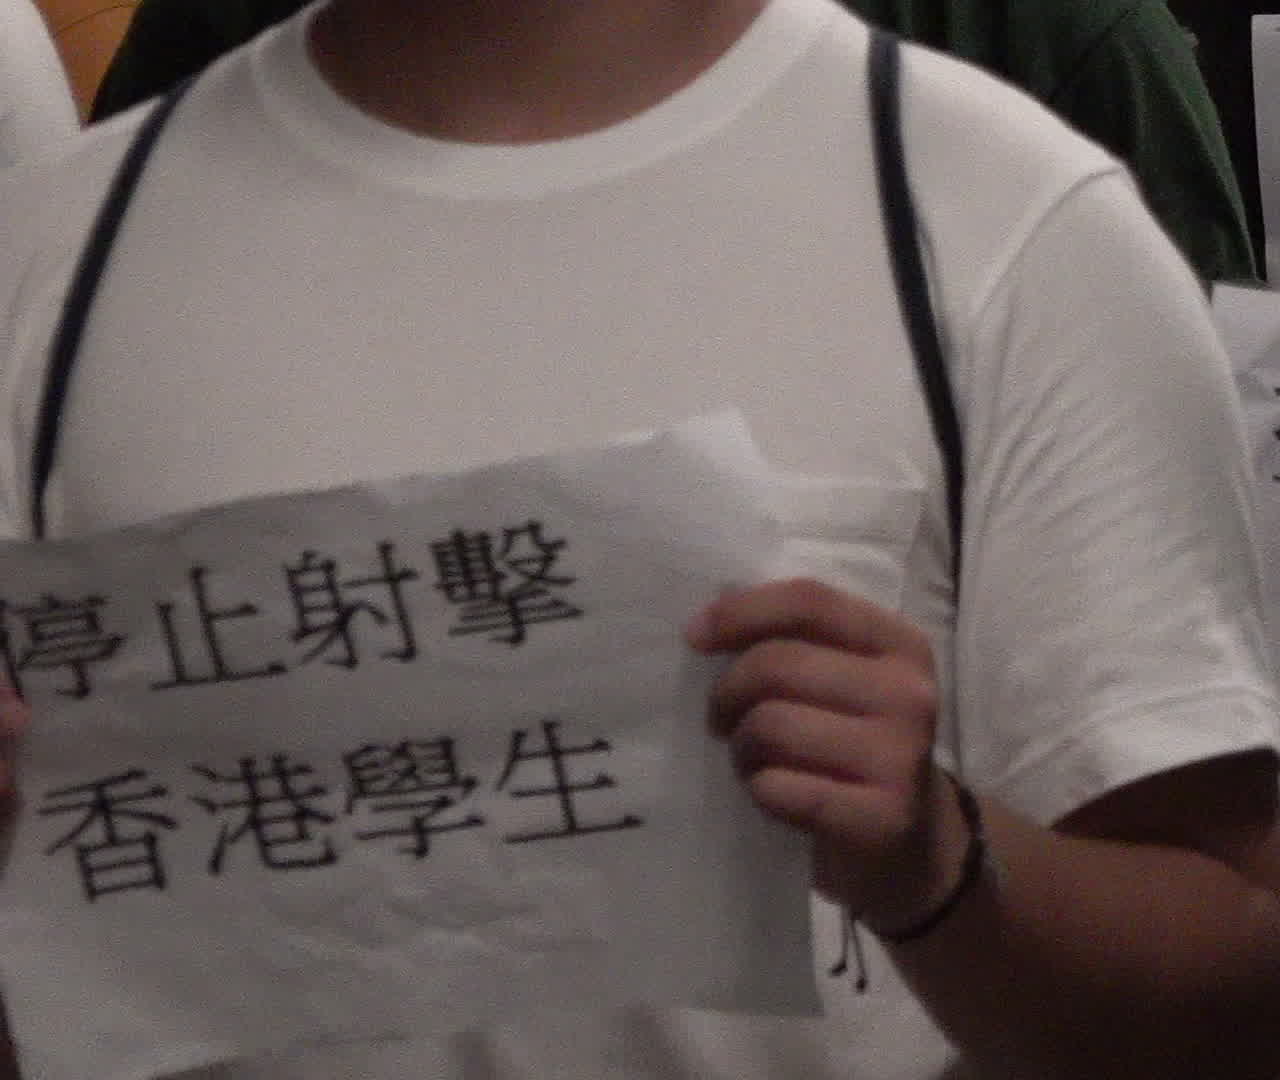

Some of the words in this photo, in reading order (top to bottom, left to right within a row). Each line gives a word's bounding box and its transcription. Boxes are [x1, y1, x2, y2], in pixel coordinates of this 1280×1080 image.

[0, 522, 583, 700] 停止射擊
[36, 720, 645, 903] 香港學生
